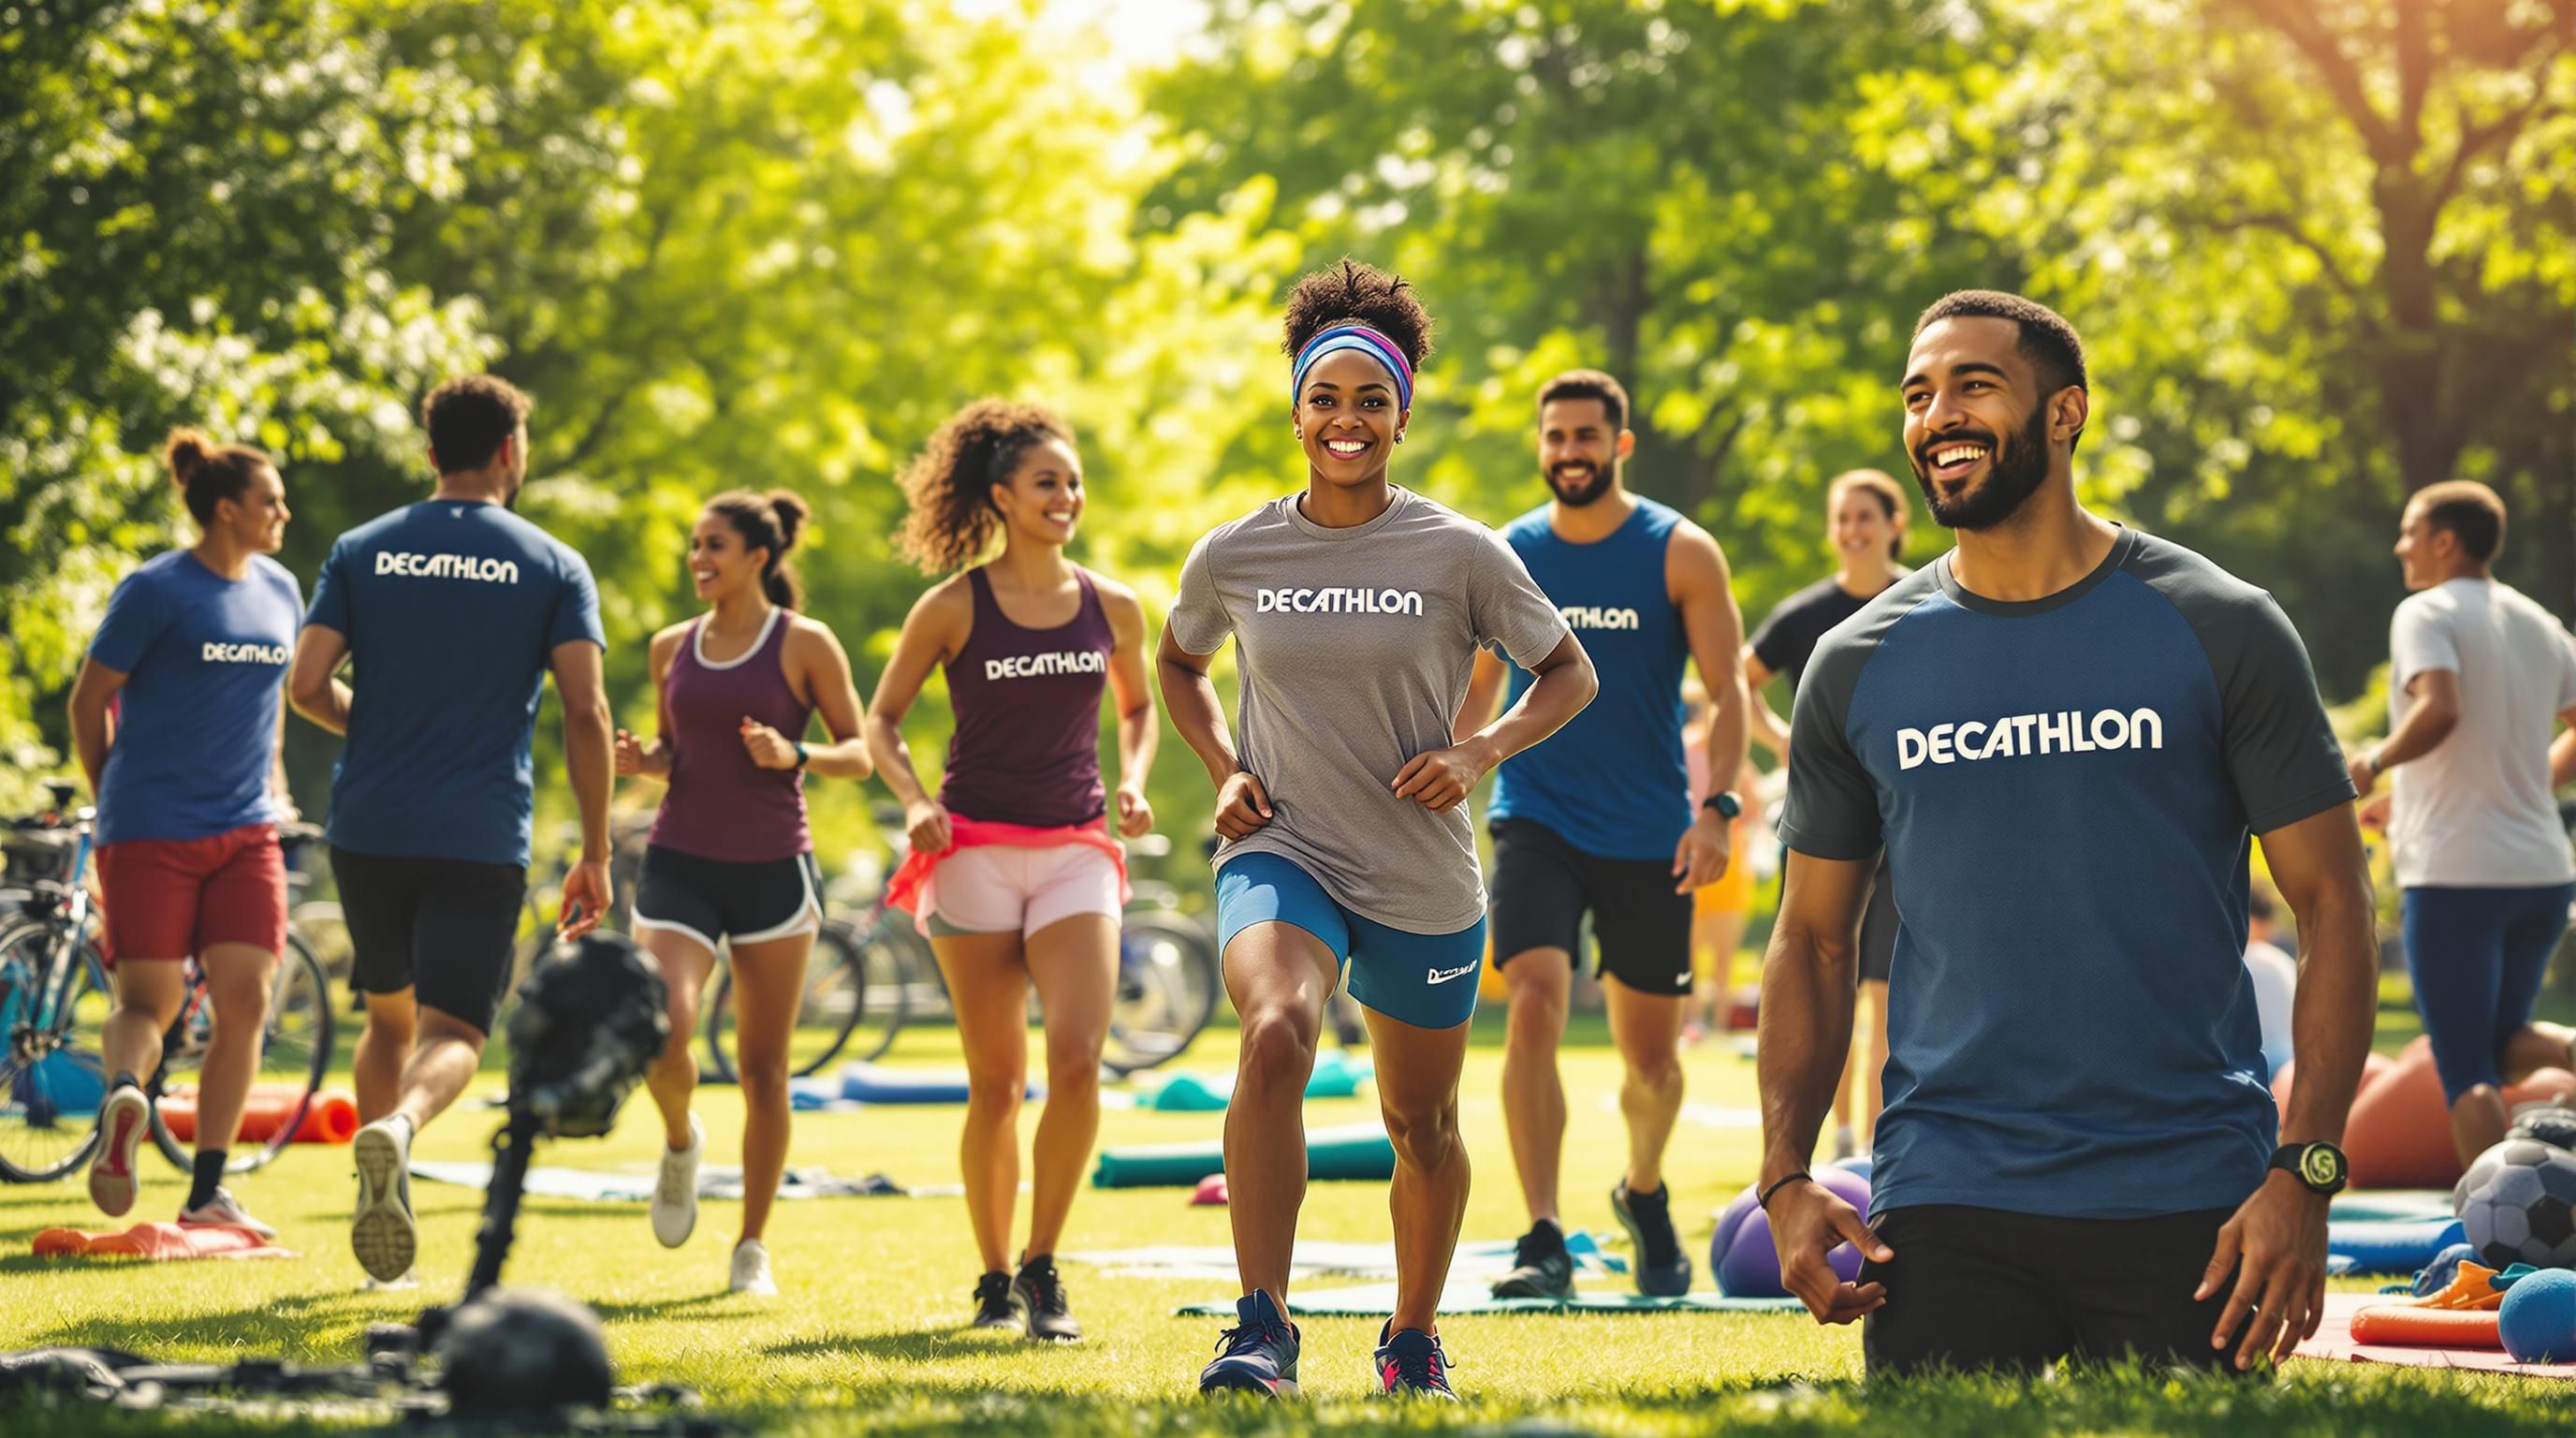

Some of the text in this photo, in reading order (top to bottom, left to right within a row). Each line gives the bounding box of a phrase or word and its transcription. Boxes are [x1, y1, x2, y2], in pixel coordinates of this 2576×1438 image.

[376, 551, 518, 583] DECATHLON
[1256, 588, 1423, 617] DECATHLON
[986, 652, 1105, 681] DECATHLON
[1896, 707, 2163, 770] DECATHLON
